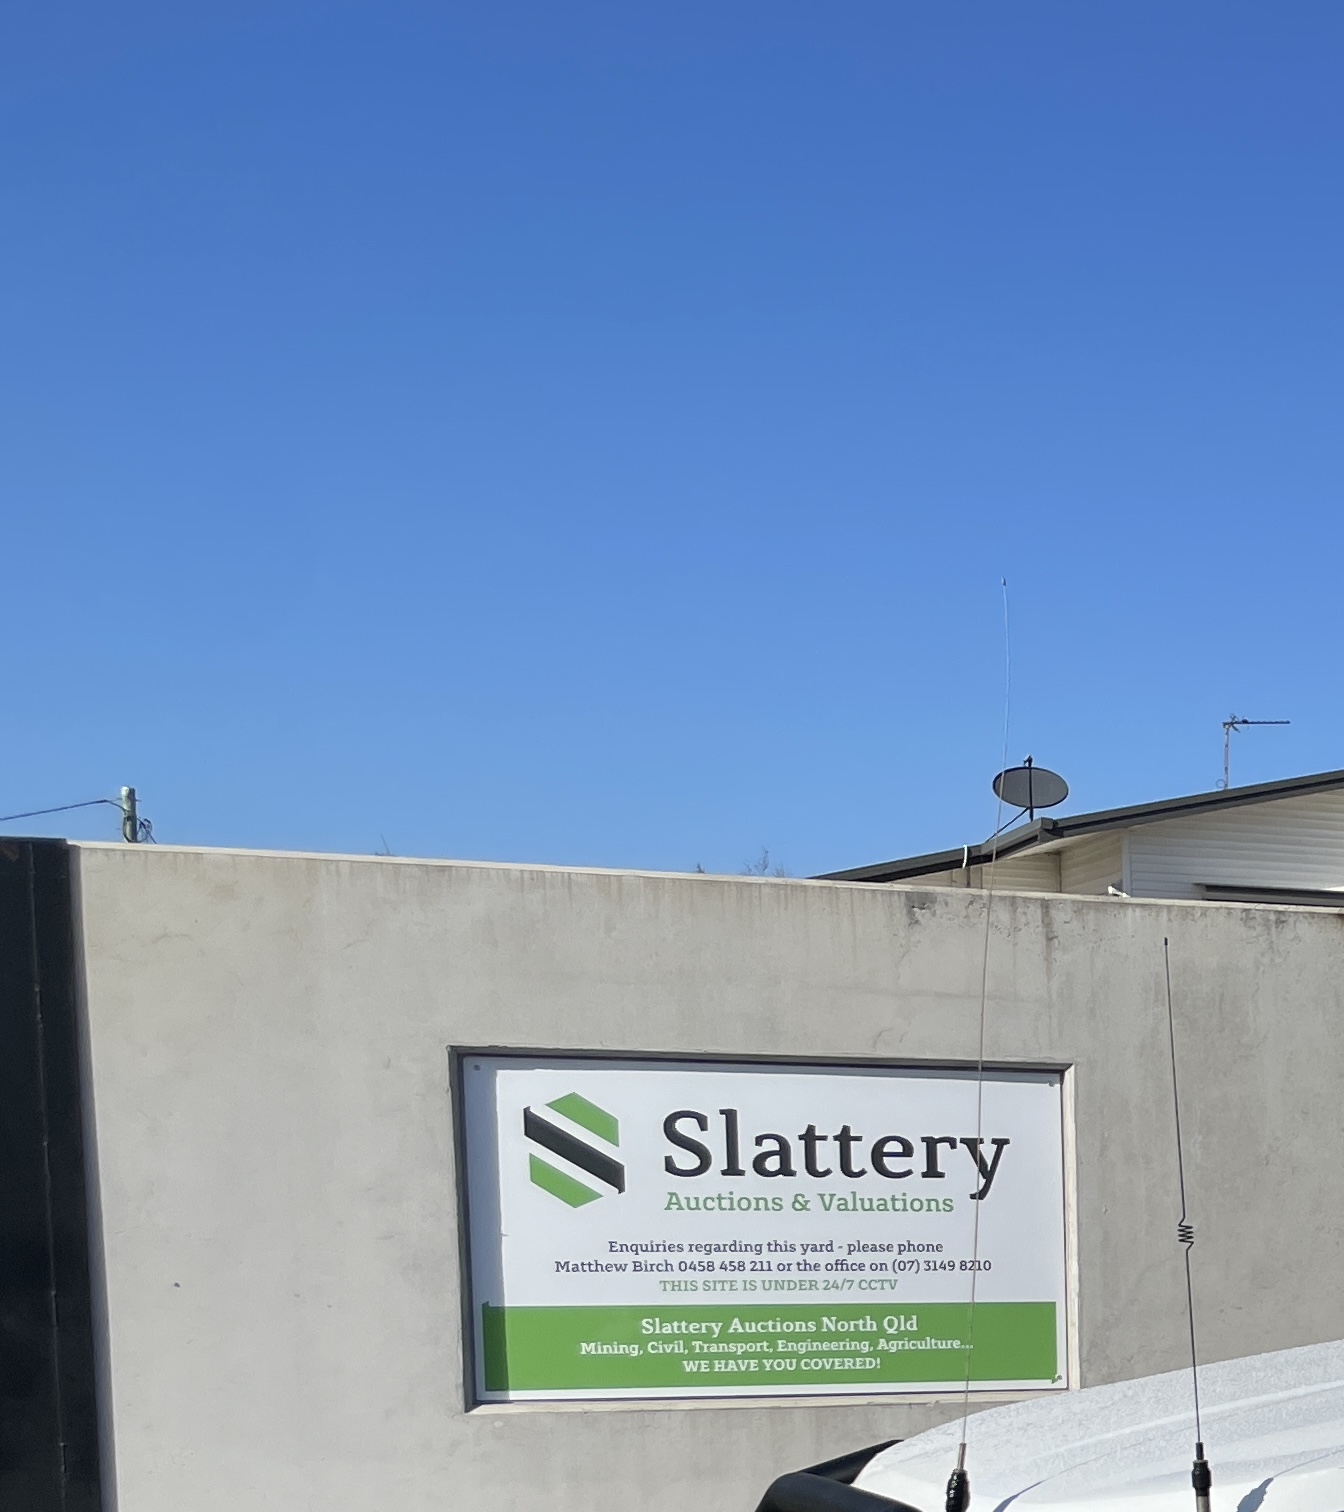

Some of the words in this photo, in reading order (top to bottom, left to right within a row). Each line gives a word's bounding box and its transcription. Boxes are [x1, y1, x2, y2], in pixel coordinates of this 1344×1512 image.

[662, 1108, 1011, 1201] Slattery
[664, 1191, 784, 1212] Auctions
[791, 1192, 811, 1212] &
[817, 1190, 955, 1213] Valuations
[608, 1239, 685, 1256] Enquiries
[688, 1239, 764, 1256] regarding
[766, 1239, 797, 1253] this
[800, 1239, 834, 1256] yard
[846, 1239, 894, 1256] please
[897, 1239, 944, 1256] phone
[555, 1259, 629, 1273] Matthew
[632, 1259, 675, 1273] Birch
[678, 1260, 716, 1273] 0458
[719, 1260, 747, 1273] 458
[750, 1260, 773, 1273] 211
[776, 1262, 793, 1272] or
[796, 1259, 821, 1272] the
[825, 1258, 867, 1272] office
[869, 1262, 889, 1272] on
[892, 1259, 920, 1275] (07)
[923, 1260, 956, 1272] 3149
[959, 1259, 992, 1272] 8210
[659, 1280, 699, 1292] THIS
[702, 1280, 739, 1292] SITE
[742, 1280, 758, 1292] IS
[761, 1279, 820, 1292] UNDER
[822, 1279, 855, 1292] 24/7
[858, 1279, 899, 1292] CCTV
[641, 1317, 723, 1339] Slattery
[727, 1316, 817, 1333] Auctions
[821, 1315, 878, 1333] North
[882, 1314, 919, 1335] Qld
[580, 1341, 644, 1357] Mining,
[647, 1340, 690, 1355] Civil,
[691, 1340, 774, 1356] Transport,
[777, 1338, 874, 1354] Engineering,
[682, 1360, 710, 1373] WE
[713, 1359, 760, 1372] HAVE
[762, 1358, 797, 1371] YOU
[800, 1357, 882, 1371] COVERED!
